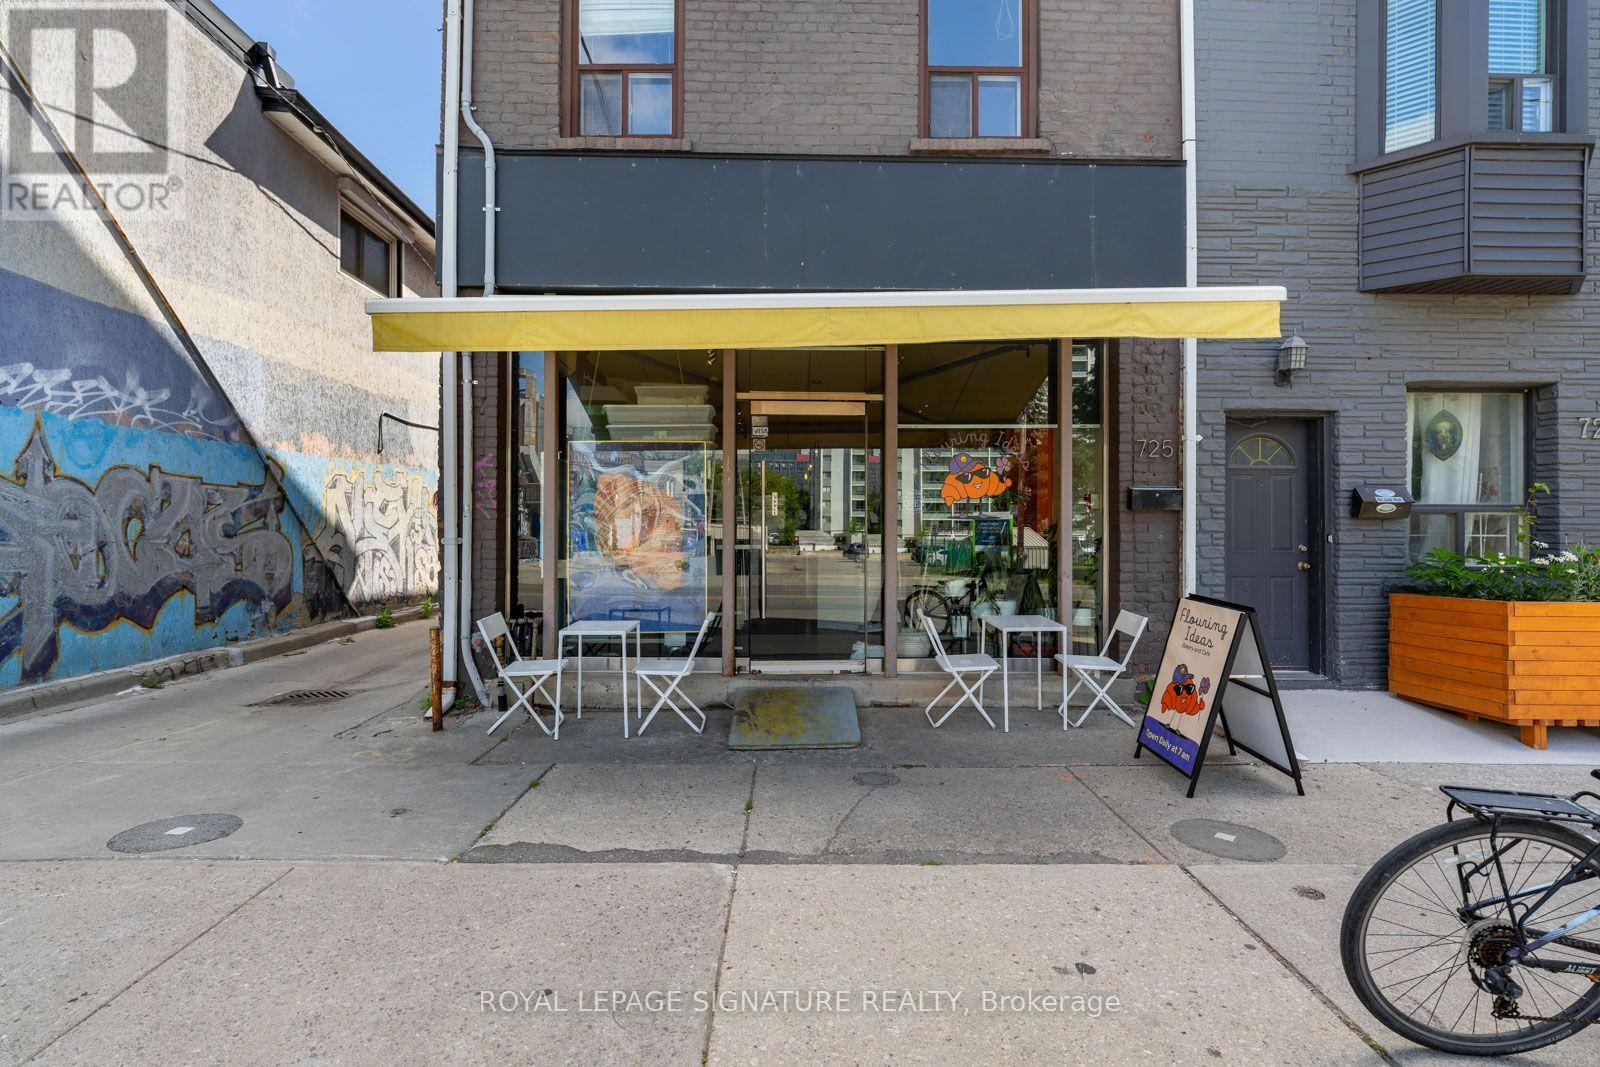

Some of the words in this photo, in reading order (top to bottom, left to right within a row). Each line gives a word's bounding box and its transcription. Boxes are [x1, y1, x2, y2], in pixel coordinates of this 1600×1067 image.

[1136, 439, 1174, 458] 725
[1180, 607, 1228, 640] Flouring
[1185, 626, 1214, 648] Ideas
[1145, 729, 1159, 742] Open
[1158, 736, 1171, 751] Daily
[1170, 746, 1178, 754] at
